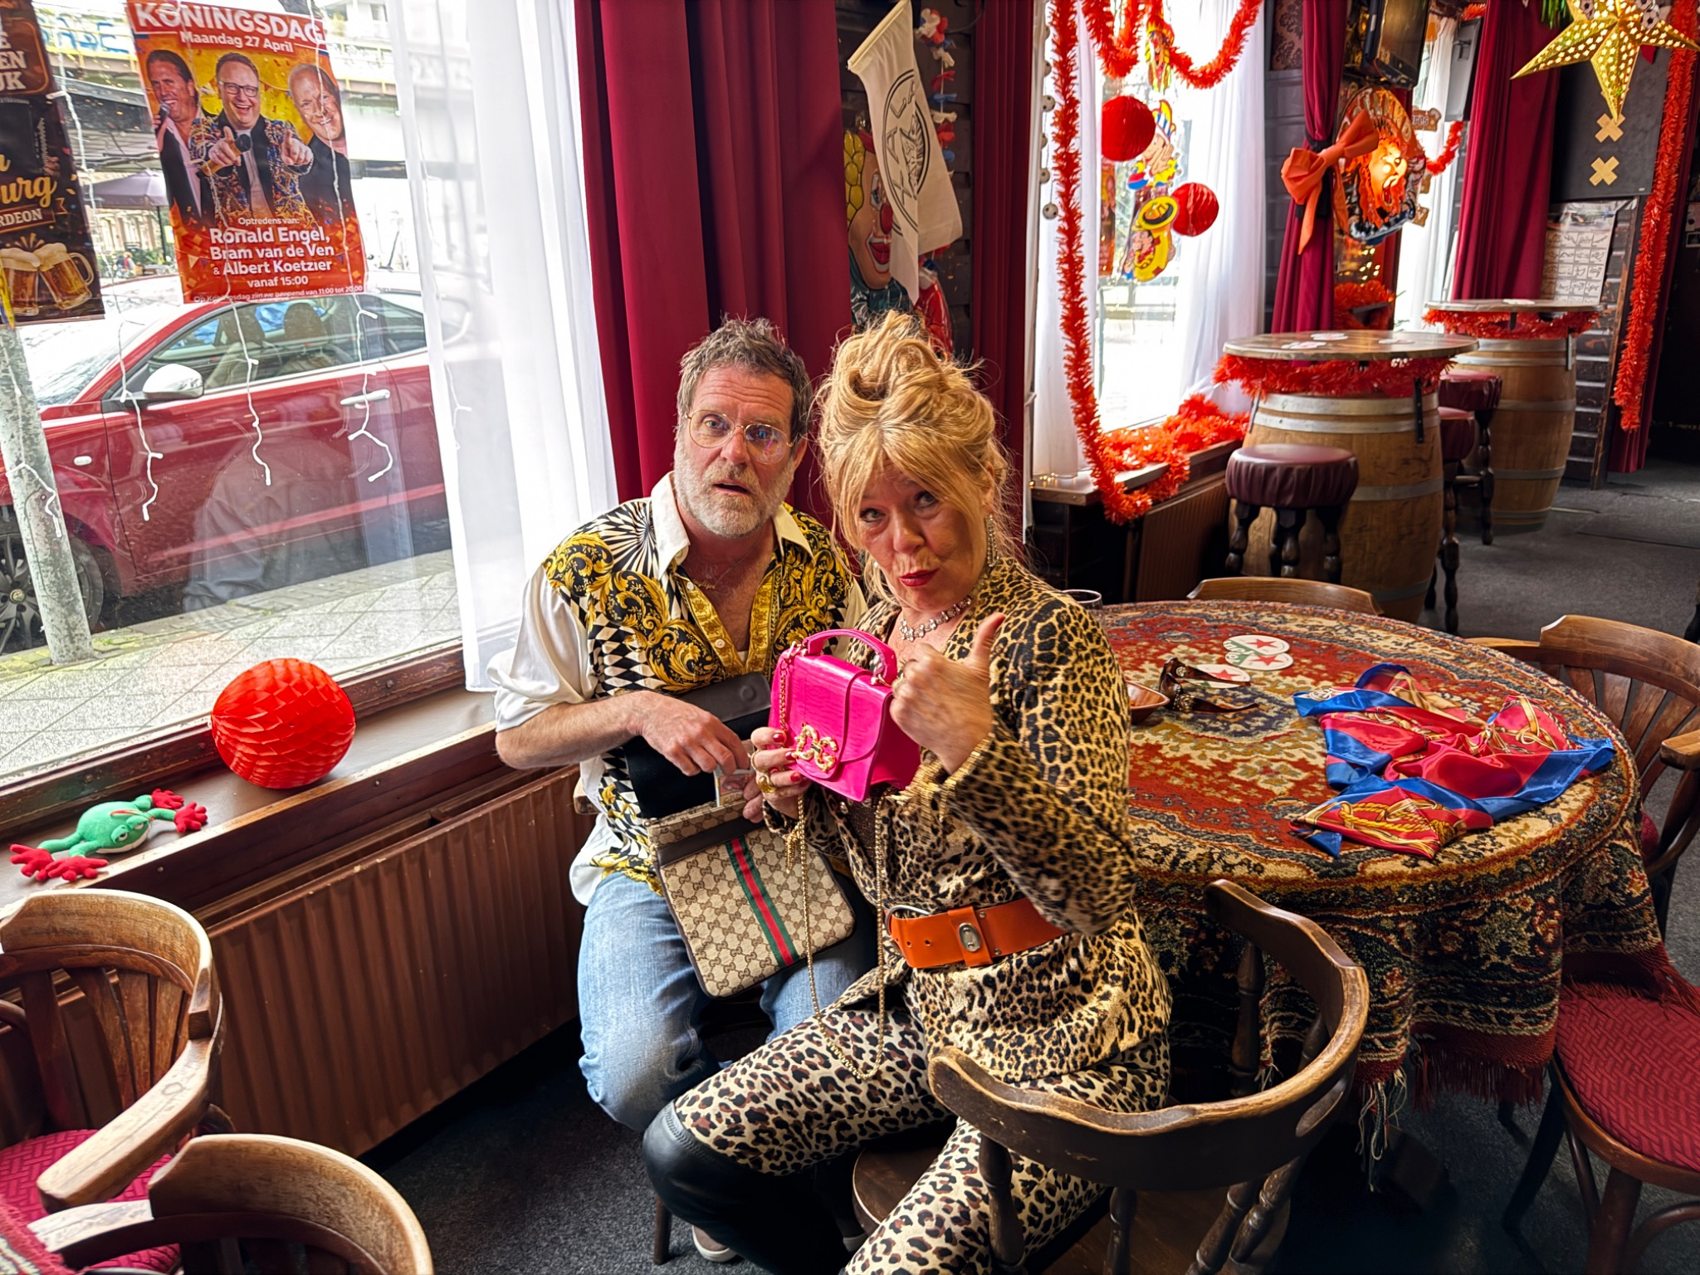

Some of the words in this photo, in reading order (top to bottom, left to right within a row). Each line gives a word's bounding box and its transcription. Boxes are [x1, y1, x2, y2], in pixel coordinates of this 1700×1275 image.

[135, 3, 325, 44] KONINGSDAG
[180, 30, 243, 48] Maandag
[244, 35, 260, 47] 27
[263, 37, 293, 53] April
[238, 217, 282, 226] Optredens
[209, 226, 275, 244] Ronald
[278, 225, 331, 246] Engel,
[210, 246, 253, 260] Bram
[255, 248, 283, 258] van
[286, 245, 304, 257] de
[303, 244, 335, 257] Ven
[213, 267, 220, 276] &
[223, 260, 270, 275] Albert
[273, 259, 333, 273] Koetzier
[247, 276, 279, 288] vanaf
[280, 275, 309, 286] 15:00
